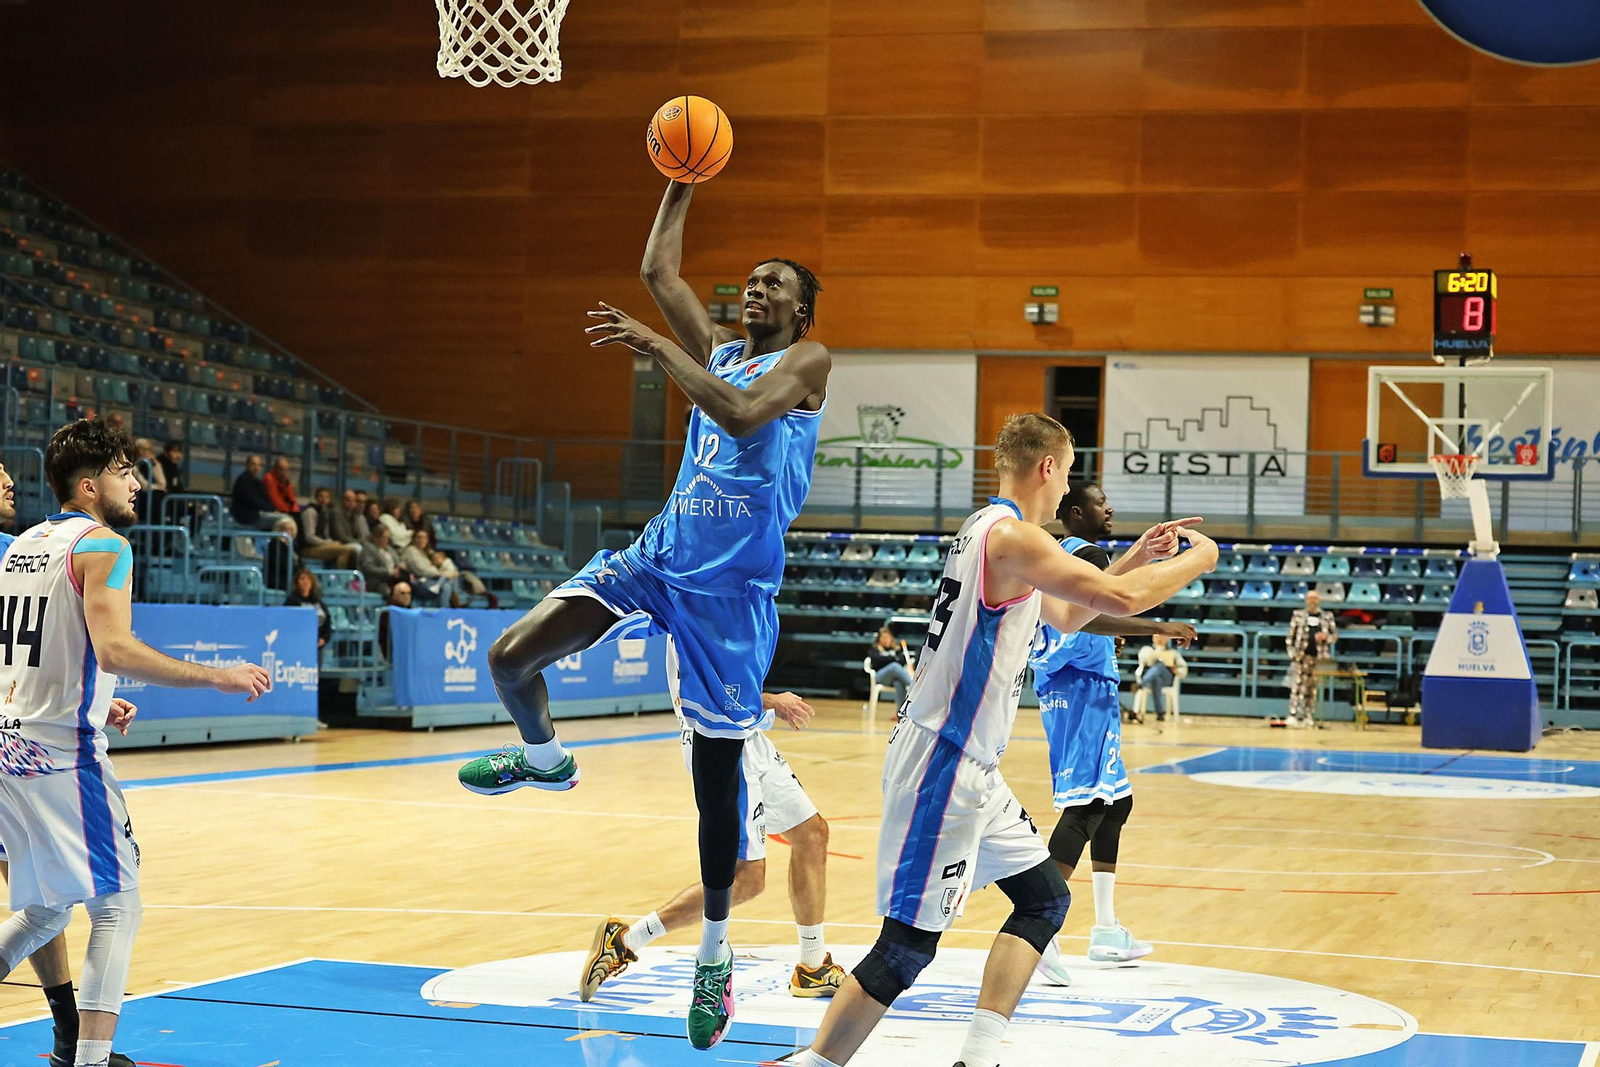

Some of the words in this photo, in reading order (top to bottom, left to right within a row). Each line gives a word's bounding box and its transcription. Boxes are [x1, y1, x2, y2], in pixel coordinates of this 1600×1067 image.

[1448, 272, 1488, 292] 6:20
[1462, 296, 1485, 331] 8
[1434, 339, 1489, 349] HUELVA
[693, 433, 720, 469] 12
[1124, 452, 1286, 476] GESTA
[5, 551, 50, 573] GARCÍA
[921, 576, 962, 652] 3
[0, 595, 49, 668] 44
[1458, 663, 1495, 672] HUELVA
